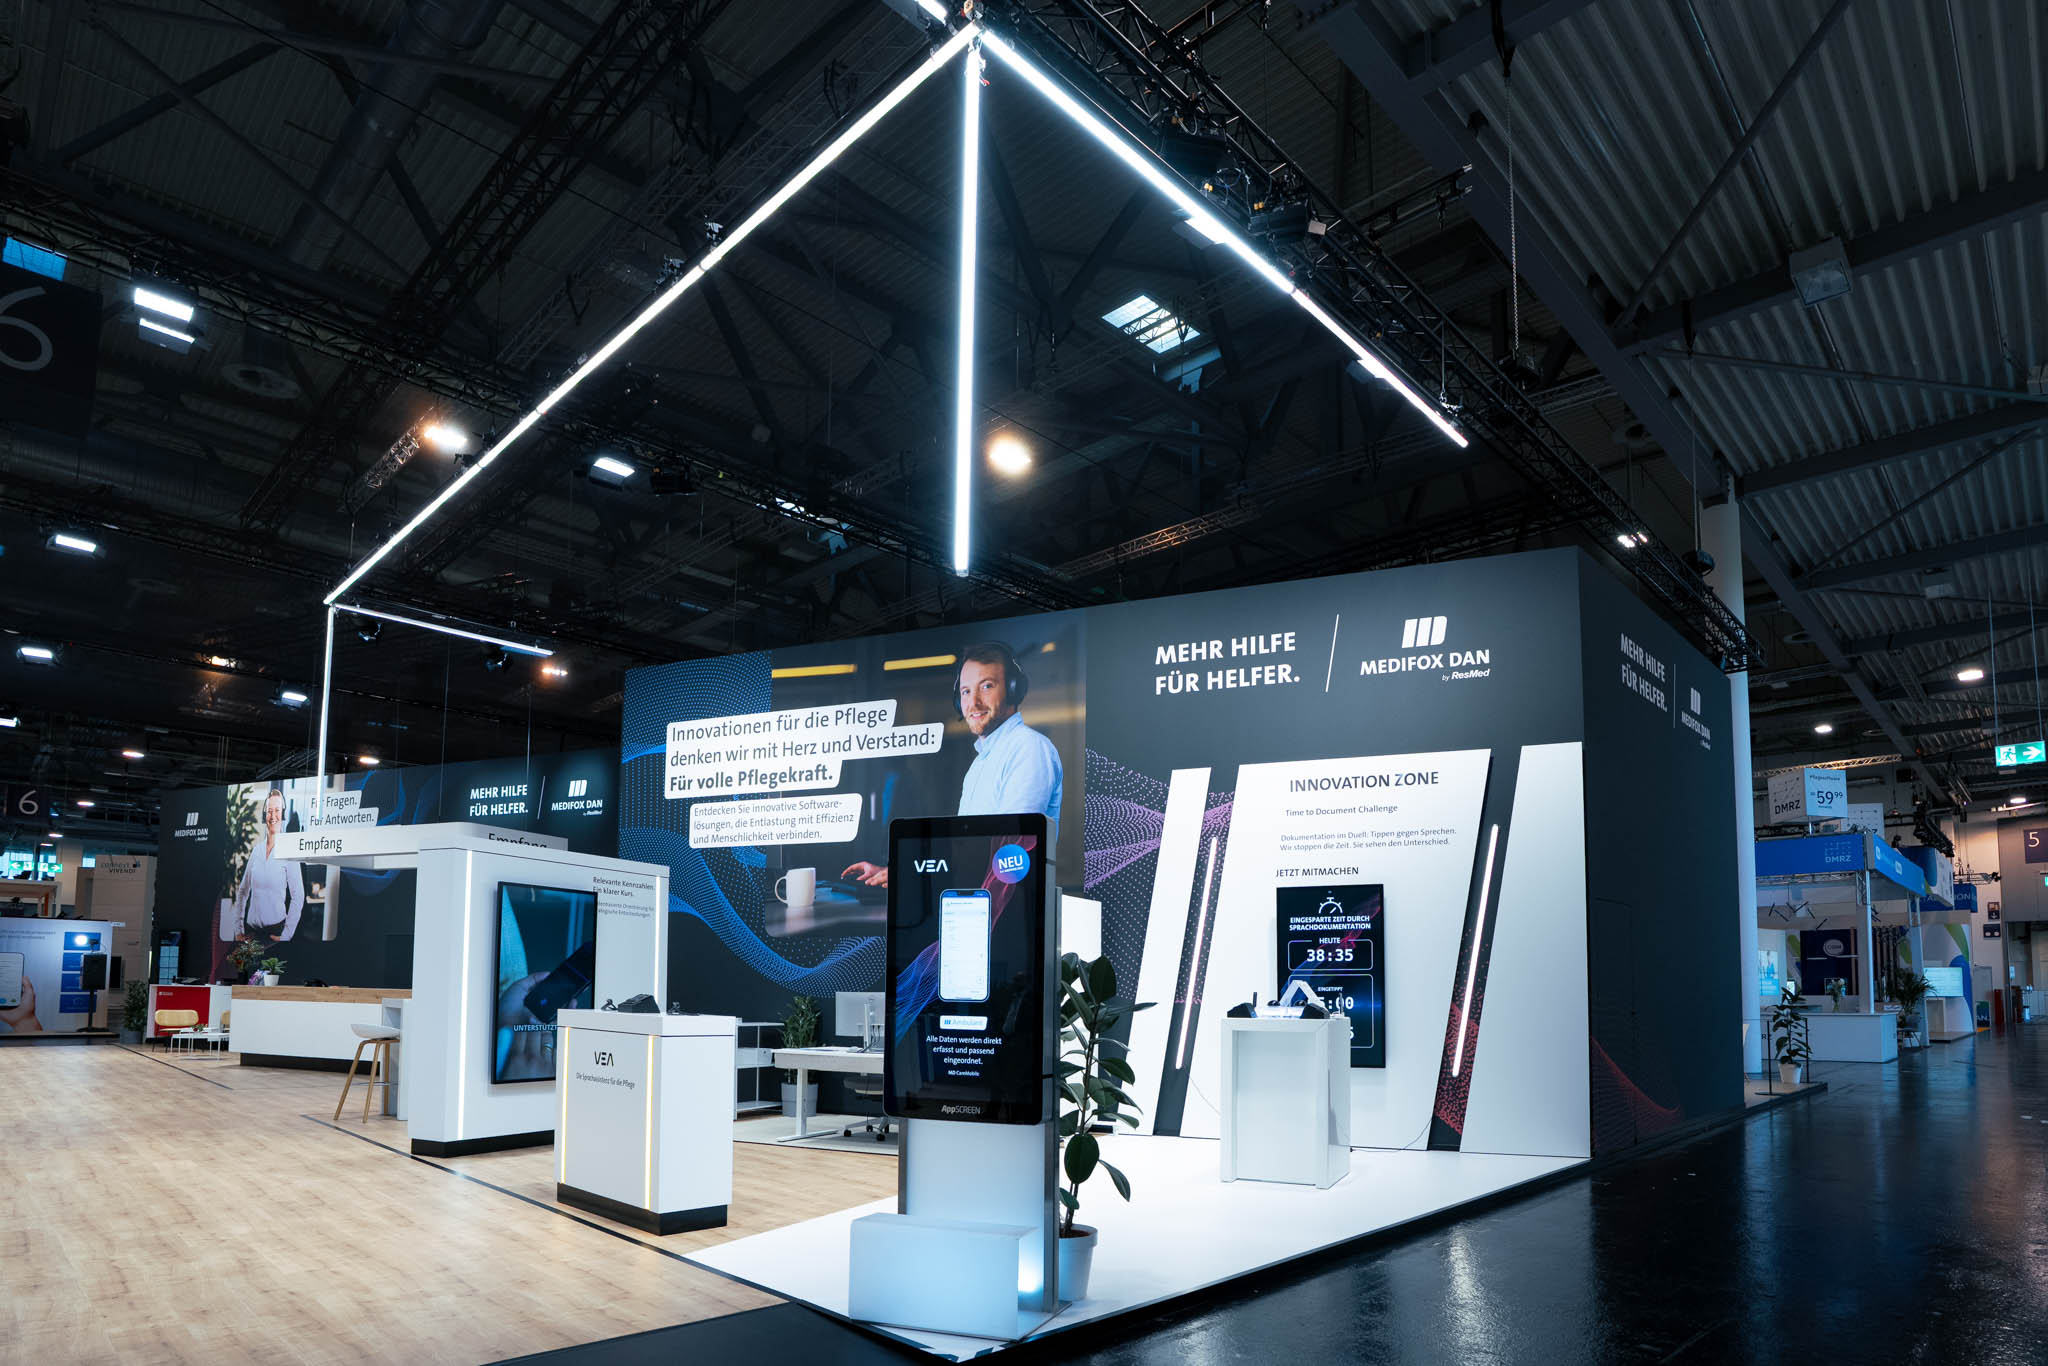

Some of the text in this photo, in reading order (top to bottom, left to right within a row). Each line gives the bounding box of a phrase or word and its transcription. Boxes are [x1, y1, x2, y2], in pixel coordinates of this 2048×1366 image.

[1155, 632, 1296, 665] MEHR HILFE
[1360, 649, 1490, 675] MEDIFOX DAN
[1620, 633, 1666, 683] MEHR HILFE
[1155, 663, 1300, 695] FÜR HELFER.
[1441, 669, 1490, 682] by ResMed
[1621, 664, 1668, 712] FÜR HELFER.
[671, 707, 888, 743] Innovationen für die Pflege
[670, 729, 935, 767] denken wir mit Herz und Verstand:
[670, 764, 833, 792] Für volle Pflegekraft.
[1290, 771, 1439, 792] INNOVATION ZONE
[470, 784, 528, 800] MEHR HILFE
[1817, 791, 1834, 805] 59
[18, 790, 39, 815] 6
[326, 796, 358, 810] Fragen.
[469, 802, 529, 817] FÜR HELFER.
[551, 799, 603, 811] MEDIFOX DAN
[694, 799, 843, 817] Entdecken Sie innovative Software-
[1774, 800, 1801, 815] DMRZ
[1285, 809, 1304, 817] Time
[1315, 807, 1356, 816] Document
[1358, 804, 1398, 814] Challenge
[325, 812, 375, 825] Antworten.
[693, 812, 854, 834] lösungen, die Entlastung mit Effizienz
[693, 827, 822, 844] und Menschlichkeit verbinden.
[1280, 833, 1336, 842] Dokumentation
[1347, 831, 1369, 839] Duell:
[1370, 830, 1395, 840] Tippen
[1396, 830, 1419, 839] gegen
[1420, 827, 1457, 838] Sprechen.
[2028, 831, 2040, 848] 5
[299, 836, 343, 853] Empfang
[1293, 843, 1322, 852] stoppen
[1323, 842, 1334, 850] die
[1352, 841, 1364, 849] Sie
[1365, 840, 1387, 848] sehen
[1388, 839, 1402, 847] den
[1403, 838, 1449, 847] Unterschied.
[914, 859, 949, 873] VEA
[998, 855, 1023, 870] NEU
[1825, 855, 1852, 863] DMRZ
[1276, 867, 1359, 878] JETZT MITMACHEN
[1289, 923, 1371, 931] SPRACHDOKUMENTATION
[1290, 916, 1331, 924] EINGESPARTE
[1306, 948, 1354, 962] 38:35
[926, 1035, 1002, 1045] Alle Daten werden direkt
[594, 1050, 614, 1067] VEA
[955, 1046, 968, 1054] und
[968, 1047, 995, 1056] passend
[943, 1056, 983, 1066] eingeordnet.
[941, 1104, 981, 1115] AppSCREEN
